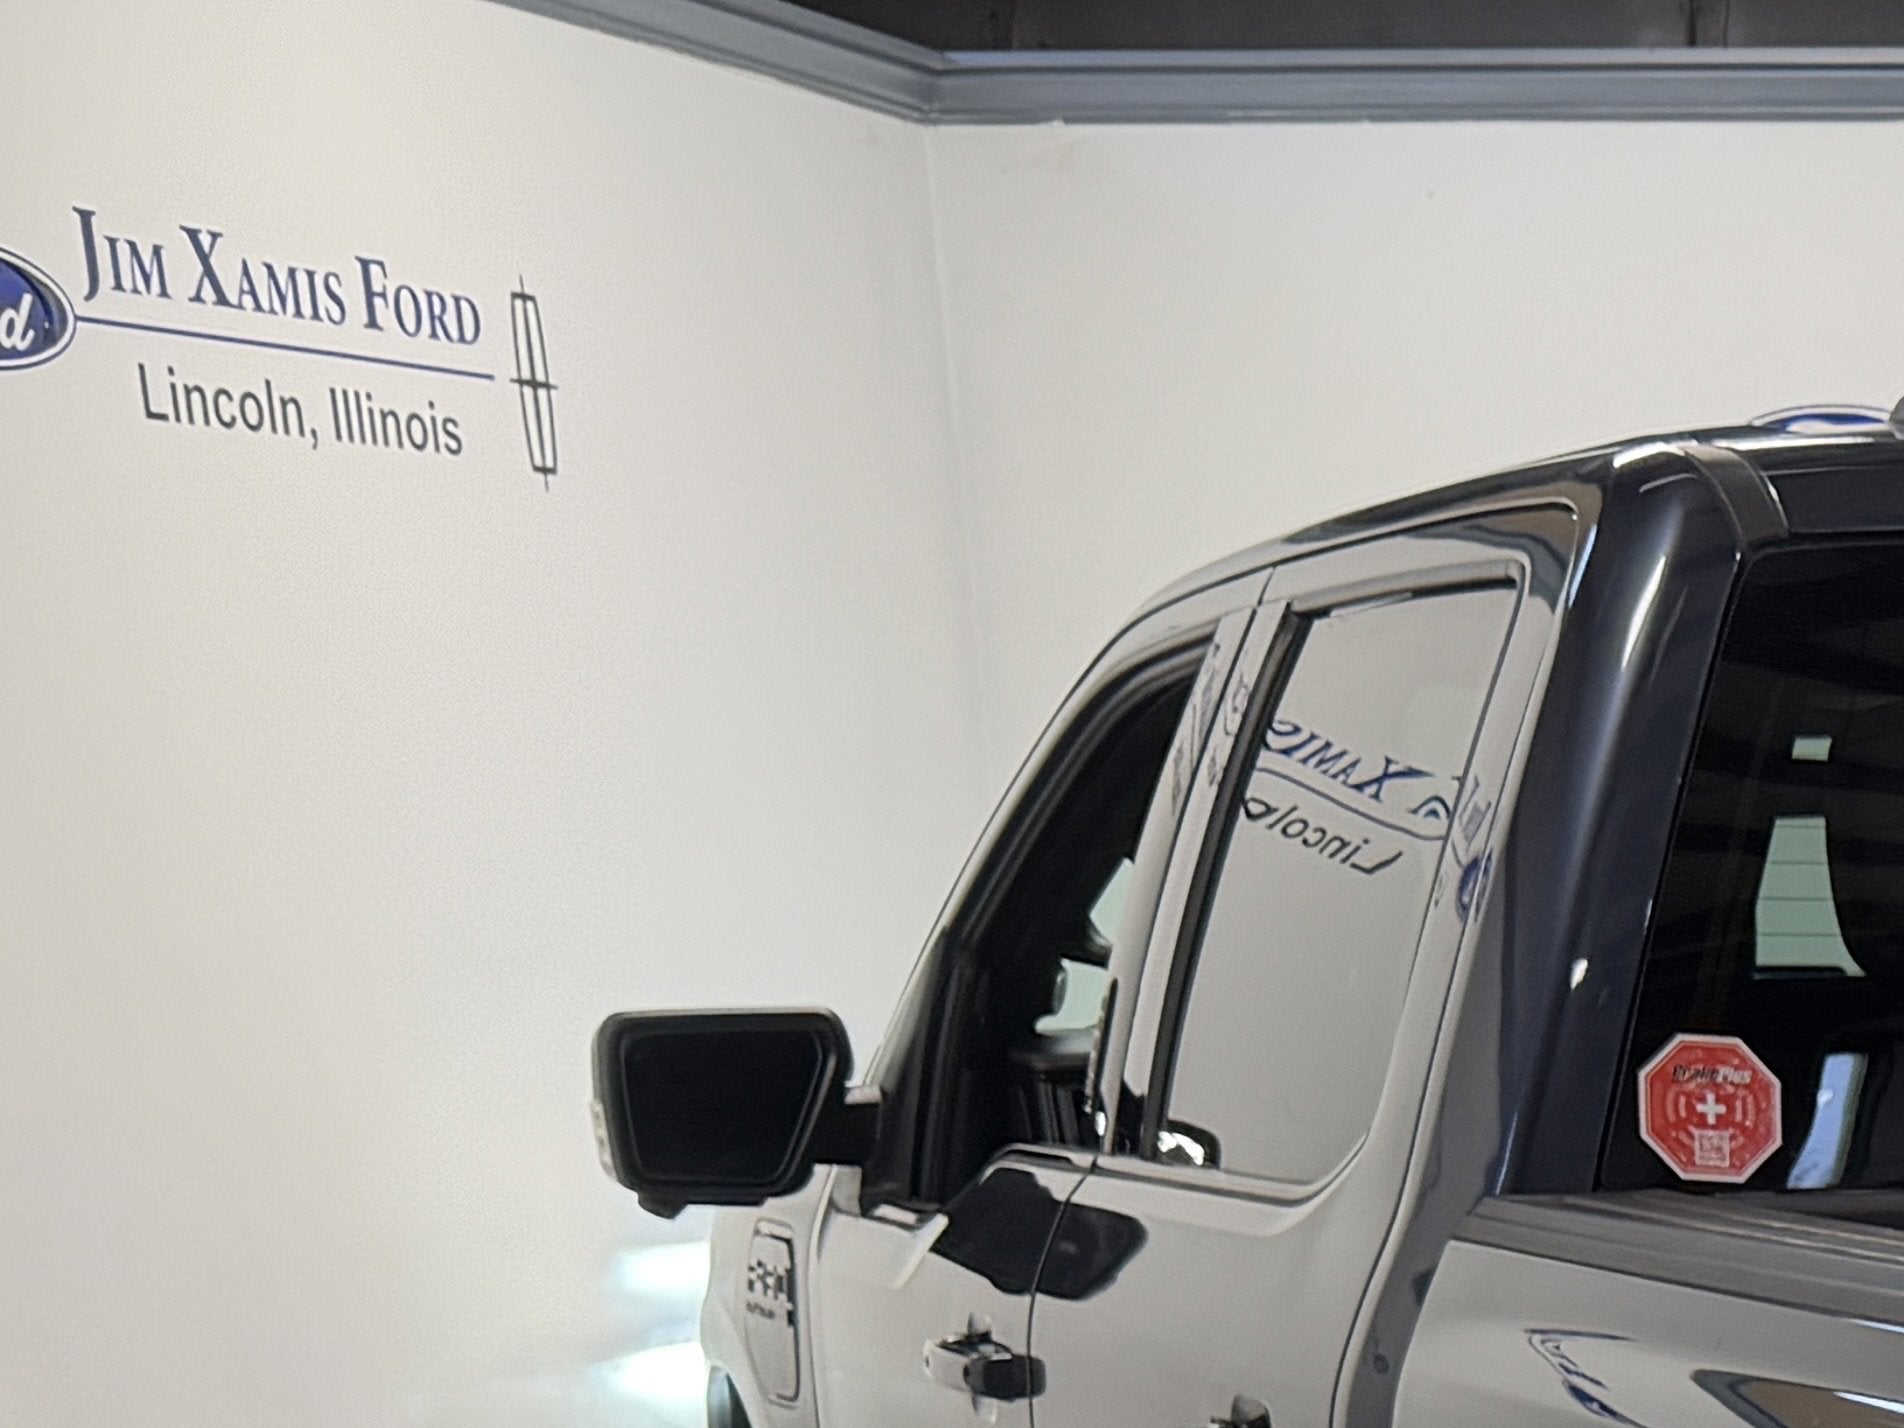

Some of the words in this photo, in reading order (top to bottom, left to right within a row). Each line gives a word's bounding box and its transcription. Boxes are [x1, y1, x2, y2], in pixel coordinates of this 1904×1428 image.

[72, 205, 172, 302] JIM
[179, 224, 347, 325] XAMIS
[354, 255, 482, 345] FORD
[137, 362, 318, 450] Lincoln,
[328, 387, 464, 456] Illinois
